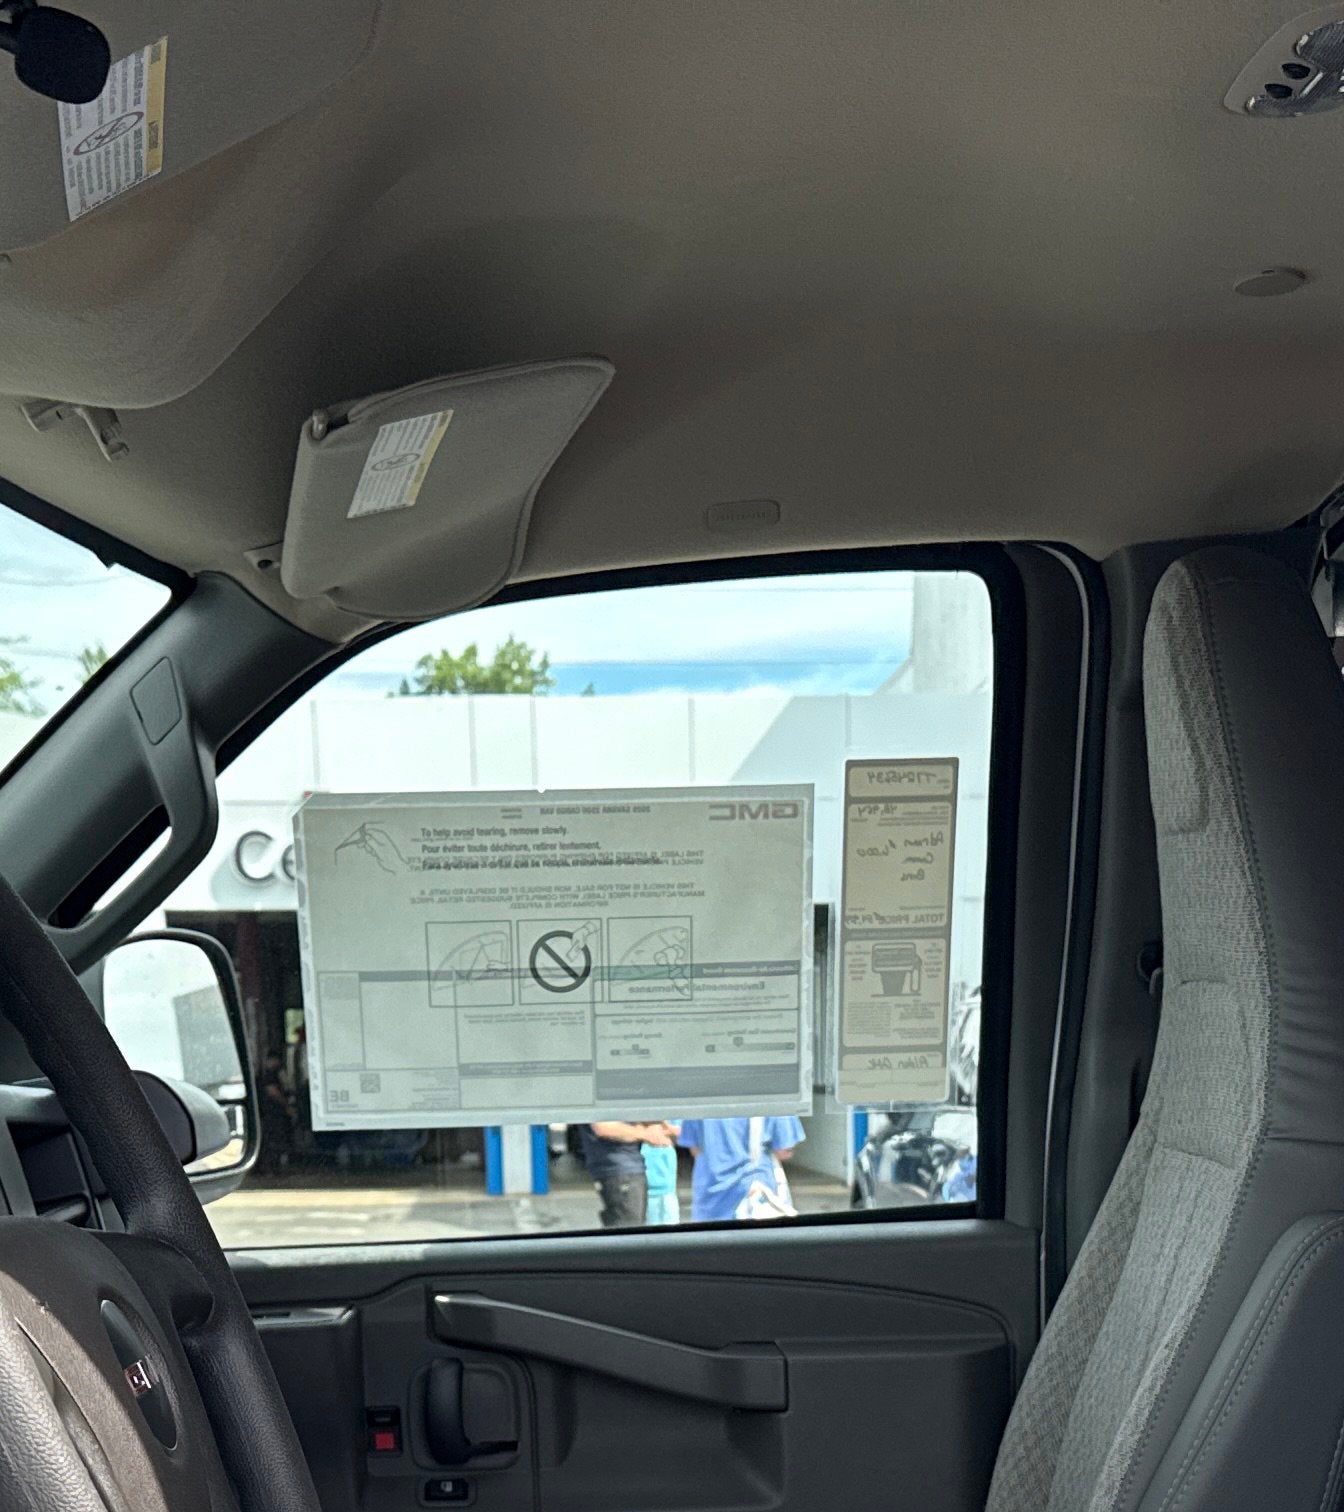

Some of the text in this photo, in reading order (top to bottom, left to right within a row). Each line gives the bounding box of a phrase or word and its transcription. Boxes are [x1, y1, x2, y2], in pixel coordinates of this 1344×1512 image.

[421, 827, 432, 837] To
[433, 827, 451, 839] help
[453, 827, 474, 837] avoid
[476, 827, 507, 838] tearing,
[509, 827, 539, 836] remove
[421, 844, 440, 853] Pour
[442, 843, 464, 853] éviter
[467, 844, 488, 853] toute
[533, 842, 557, 851] retirer
